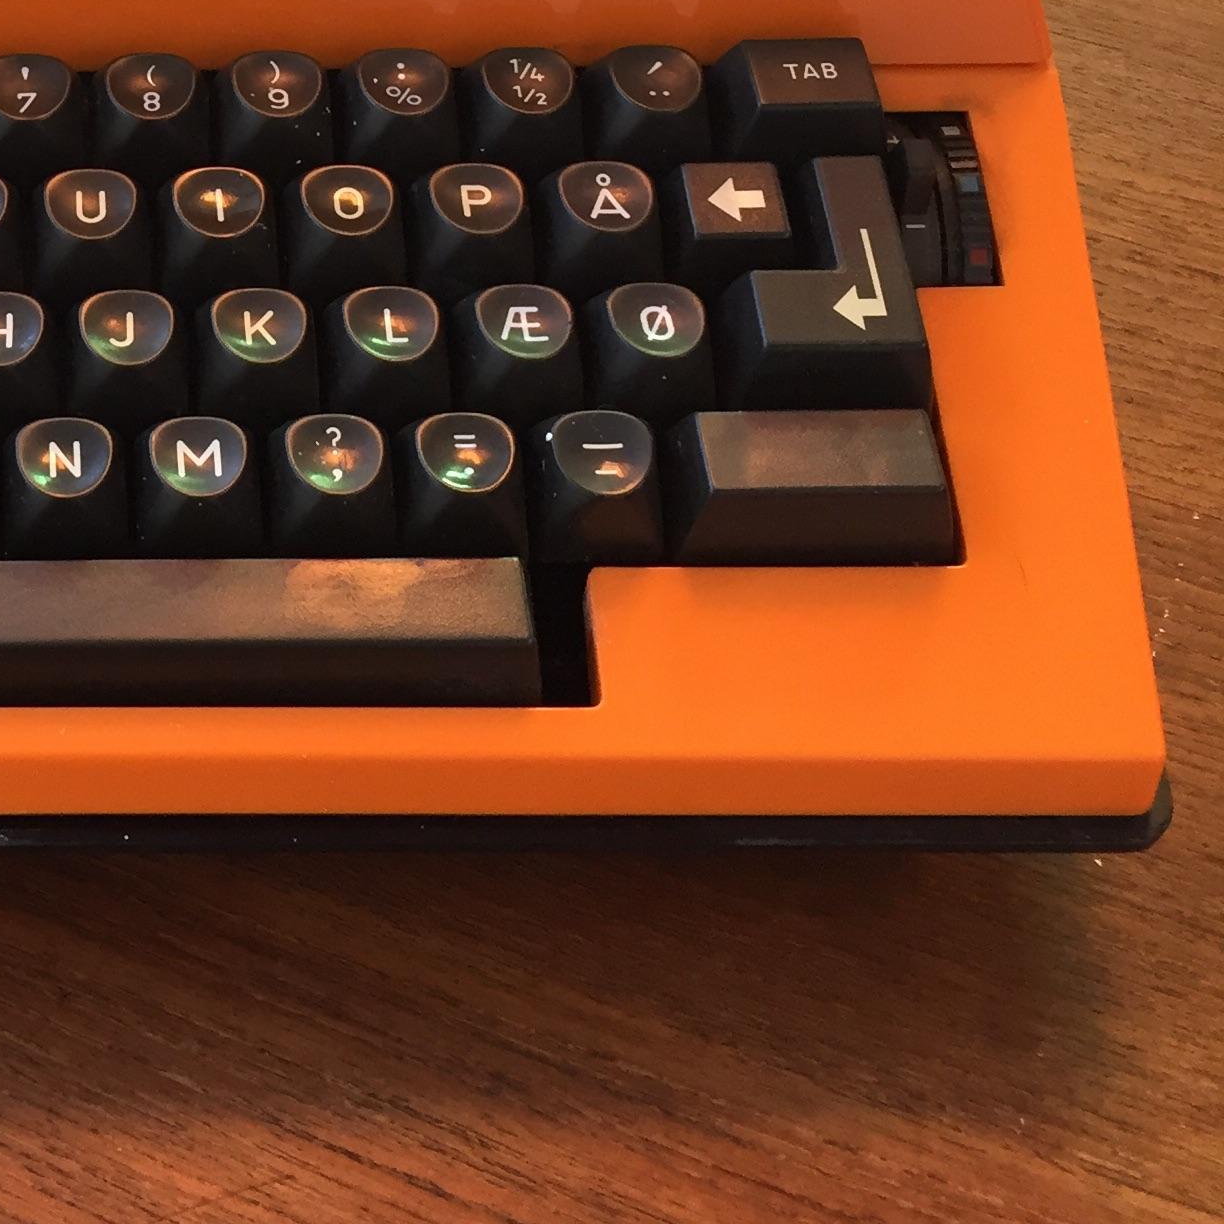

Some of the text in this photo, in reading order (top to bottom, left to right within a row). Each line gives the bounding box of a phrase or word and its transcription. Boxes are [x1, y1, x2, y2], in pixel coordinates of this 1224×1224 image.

[783, 62, 838, 80] TAB
[17, 92, 38, 113] 7
[142, 91, 161, 112] 8
[267, 87, 290, 110] 9
[75, 190, 107, 224] U
[214, 188, 225, 222] I
[460, 184, 492, 218] P
[590, 173, 631, 220] Å
[108, 311, 135, 348] J
[243, 309, 277, 345] K
[383, 308, 410, 343] L
[500, 306, 550, 342] Æ
[639, 304, 676, 341] Ø
[48, 440, 82, 478] N
[176, 439, 223, 478] M
[325, 427, 342, 457] ?
